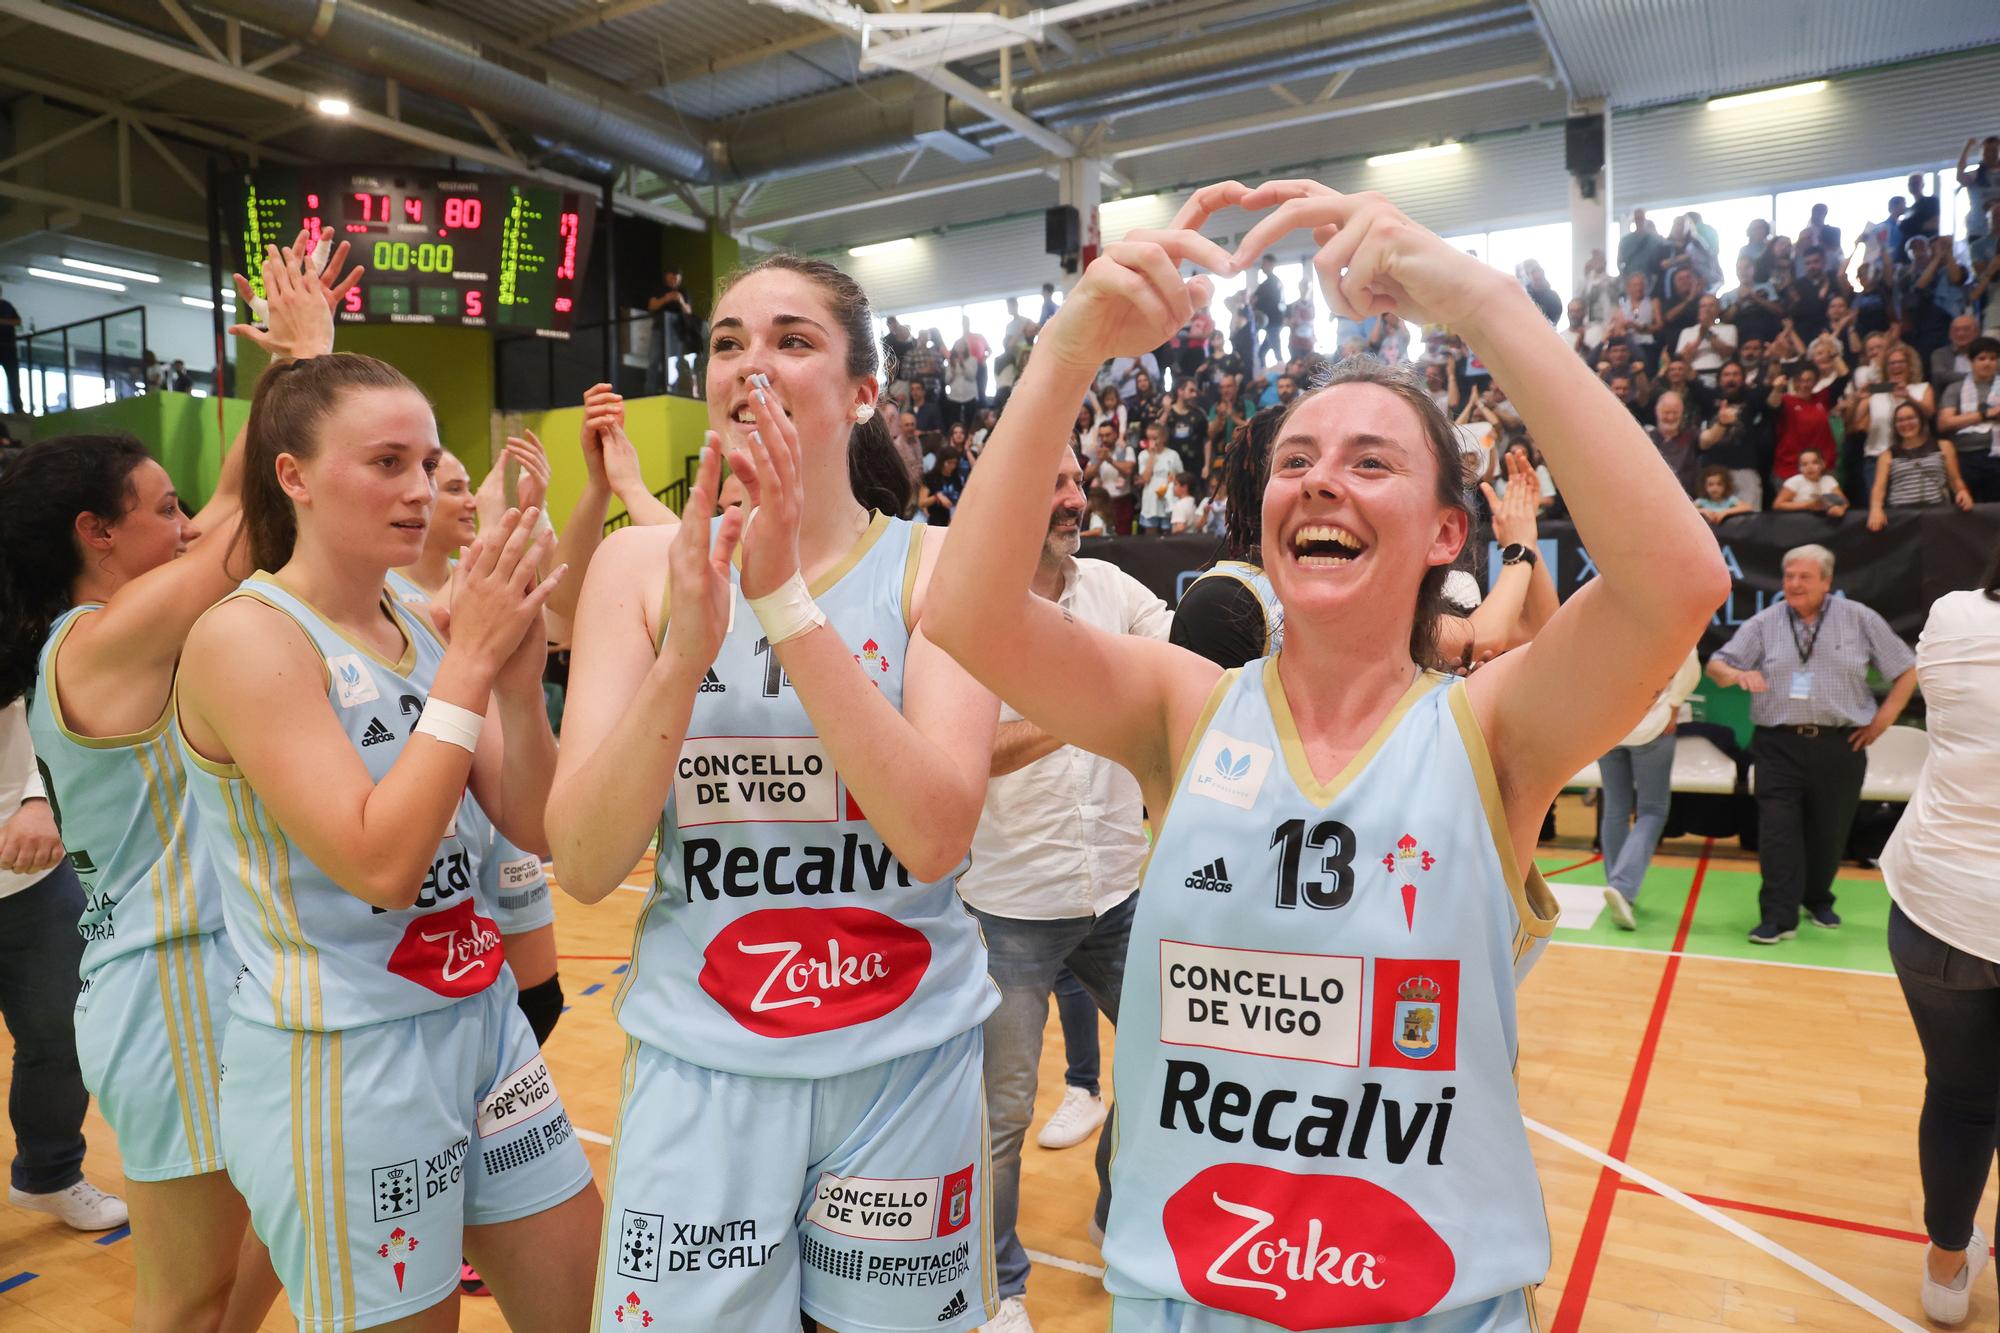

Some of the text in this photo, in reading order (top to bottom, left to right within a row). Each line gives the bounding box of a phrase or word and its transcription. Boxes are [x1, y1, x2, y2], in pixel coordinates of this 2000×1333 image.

[354, 193, 391, 222] 71
[404, 198, 423, 222] 4
[445, 197, 482, 229] 80
[373, 241, 454, 274] 00:00
[465, 290, 482, 316] 5
[754, 636, 793, 698] 1
[698, 682, 726, 693] das
[361, 732, 395, 747] adidas
[678, 754, 823, 779] CONCELLO
[696, 782, 806, 804] DE VIGO
[1269, 818, 1357, 910] 13
[1184, 874, 1233, 893] adidas
[737, 938, 890, 1013] Zorka
[1169, 963, 1344, 1004] CONCELLO
[1188, 998, 1321, 1036] DE VIGO
[494, 1082, 550, 1120] DE VIGO
[1159, 1059, 1456, 1166] Recalvi
[426, 1173, 448, 1199] DE
[826, 1203, 912, 1227] DE VIGO
[671, 1220, 756, 1246] XUNTA
[1206, 1191, 1385, 1300] Zorka
[668, 1243, 781, 1272] DE GALI
[869, 1241, 969, 1272] DEPUTACIÓN
[867, 1260, 970, 1287] PONTEVEDRA
[938, 1300, 969, 1322] adidas
